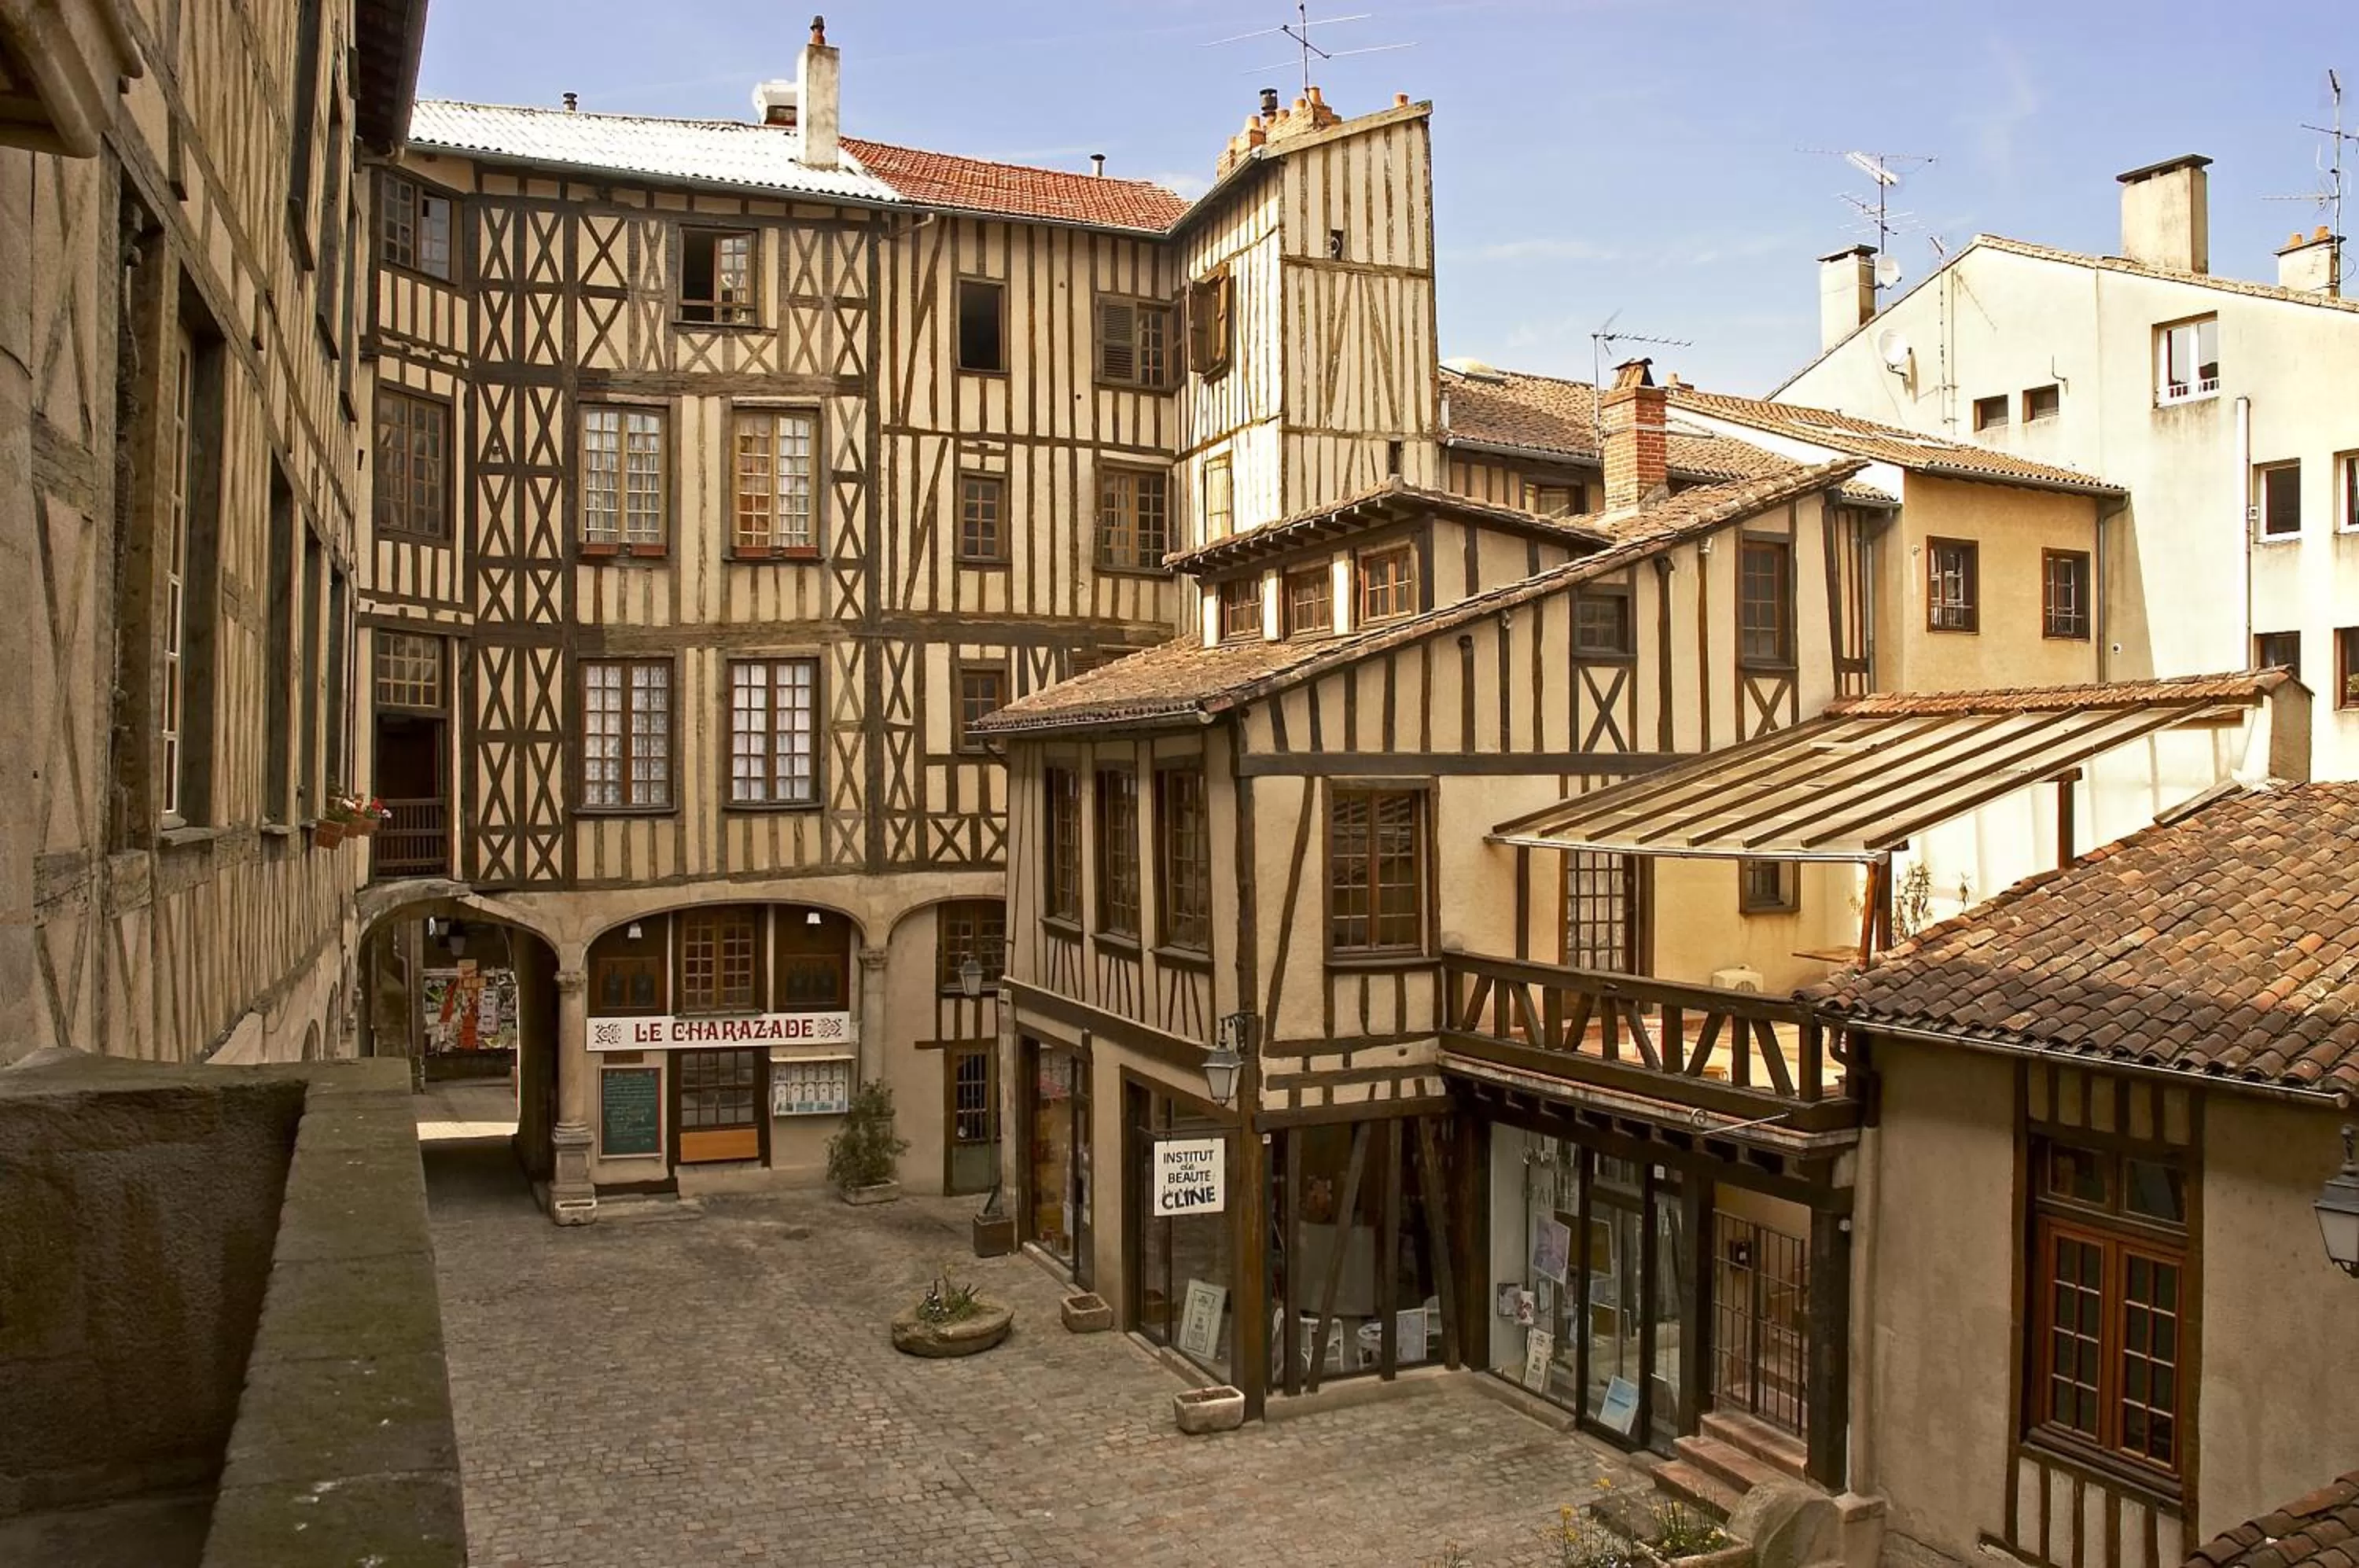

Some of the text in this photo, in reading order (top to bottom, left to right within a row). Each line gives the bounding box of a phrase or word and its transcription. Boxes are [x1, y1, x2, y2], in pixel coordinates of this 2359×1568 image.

[635, 1019, 814, 1042] LE CHARAZADE
[1163, 1150, 1214, 1164] INSTITUT
[1162, 1187, 1216, 1209] CLINE
